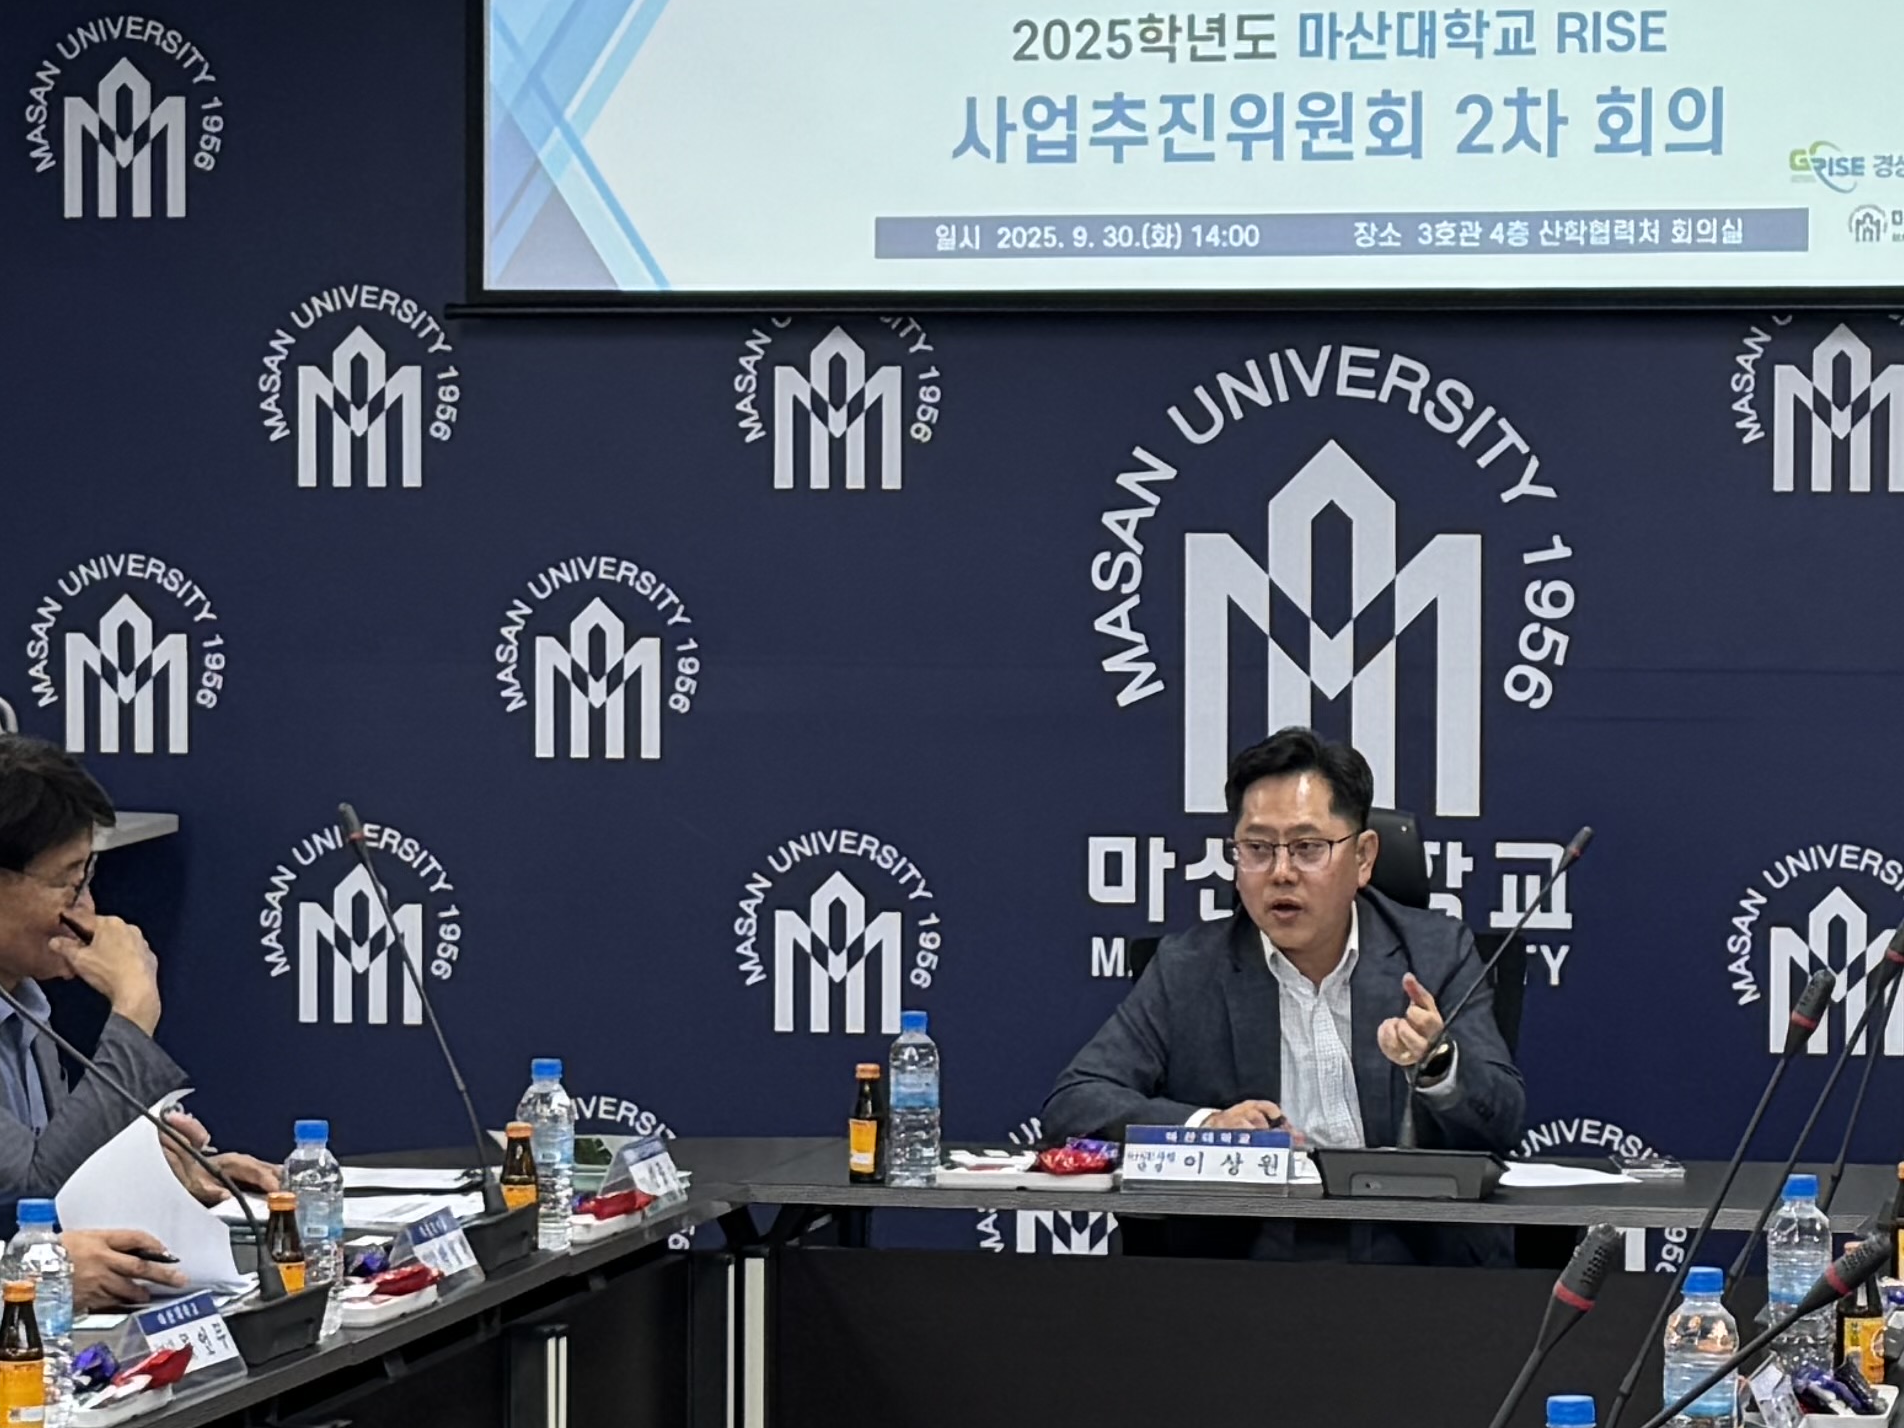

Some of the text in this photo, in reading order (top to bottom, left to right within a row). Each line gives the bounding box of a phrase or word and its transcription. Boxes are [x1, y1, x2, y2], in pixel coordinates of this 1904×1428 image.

[26, 16, 223, 172] MASAN UNIVERSITY 1956
[1012, 9, 1668, 63] 2025학년도 마산대학교 RISE
[952, 86, 1724, 164] 사업추진위원회 2차 회의
[935, 225, 981, 252] 일시
[997, 226, 1066, 249] 2025.
[1191, 225, 1260, 248] 14:00
[1353, 221, 1401, 248] 장소
[1418, 221, 1483, 248] 3호관
[1489, 221, 1530, 248] 4층
[1538, 218, 1660, 247] 산학협력처
[1671, 218, 1744, 246] 회의실
[259, 285, 459, 441] MASAN UNIVERSITY 1956
[734, 330, 941, 442] MASAN 1956
[1731, 327, 1771, 444] MASAN
[1091, 345, 1574, 709] MASAN UNIVERSITY 1956
[27, 554, 225, 709] MASAN UNIVERSITY 1956
[496, 557, 699, 713] MASAN UNIVERSITY 1956
[260, 823, 461, 979] MASAN UNIERSITY 1956
[734, 830, 941, 988] MASAN UNIVERSITY 1956
[1727, 888, 1767, 1005] MASAN
